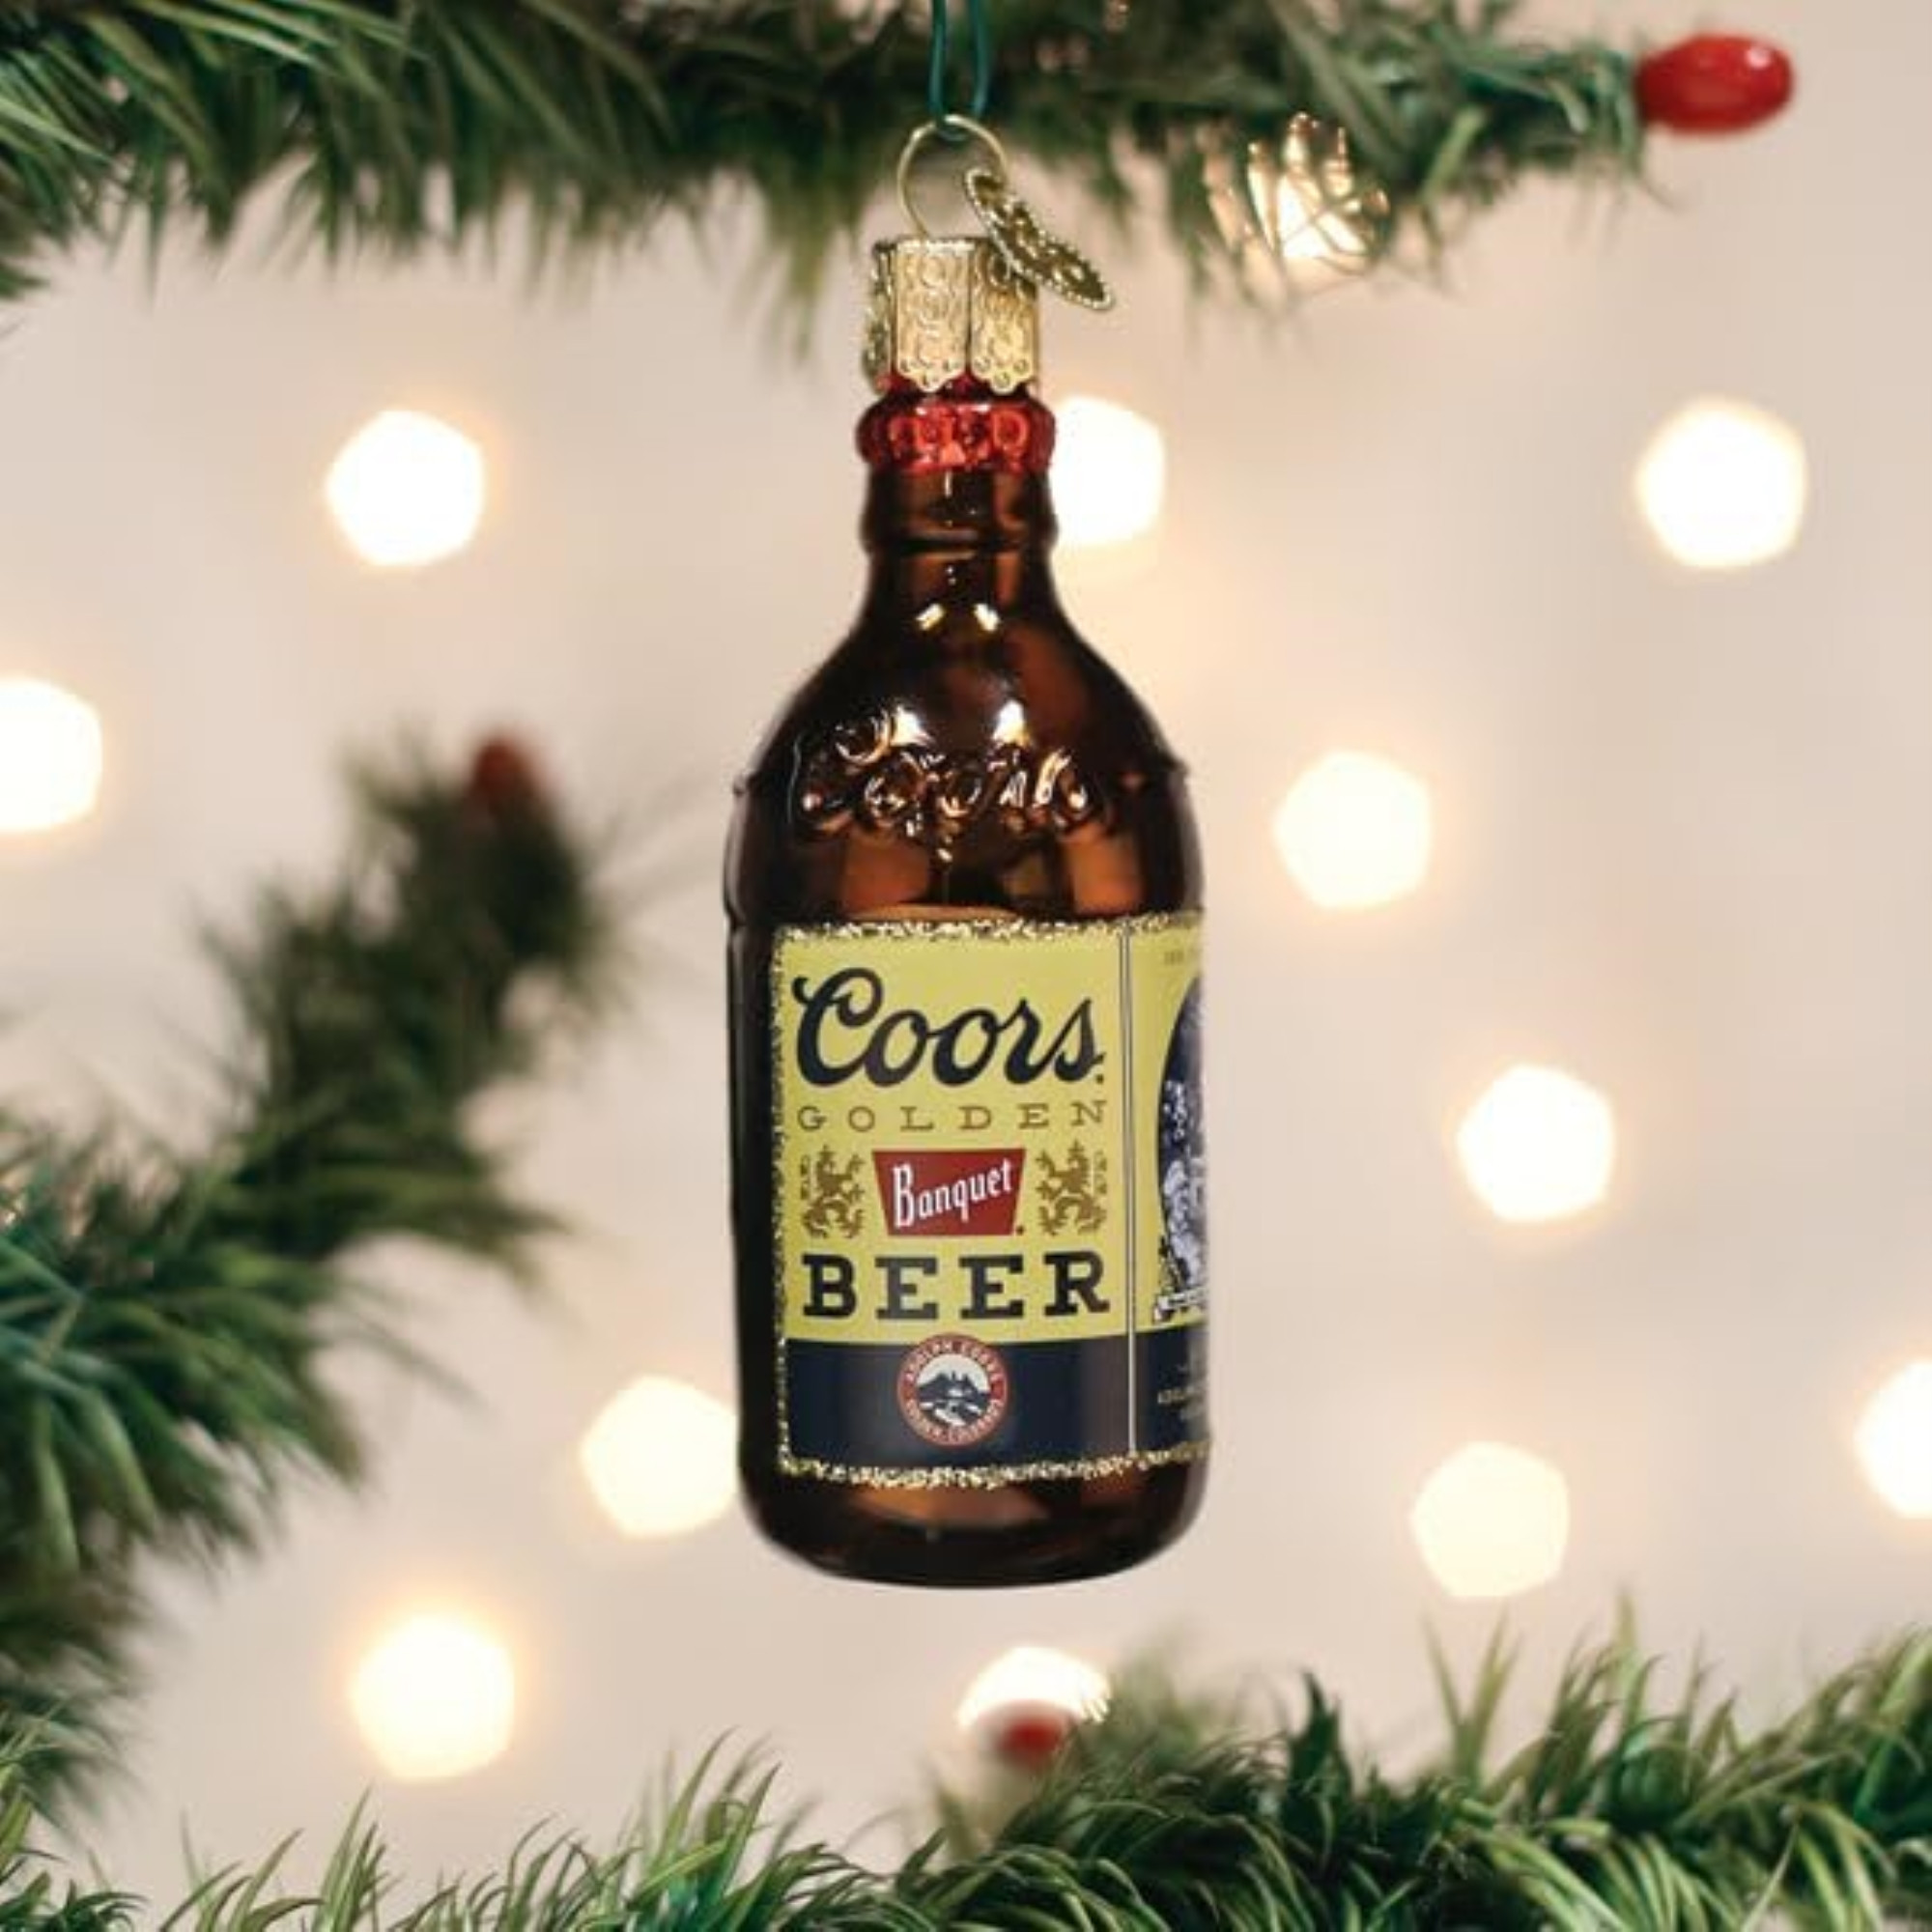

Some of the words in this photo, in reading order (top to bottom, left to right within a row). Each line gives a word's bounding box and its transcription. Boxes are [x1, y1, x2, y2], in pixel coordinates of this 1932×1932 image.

[797, 1099, 1107, 1133] GOLDEN
[893, 1158, 1012, 1228] Banquet
[801, 1251, 1111, 1320] BEER
